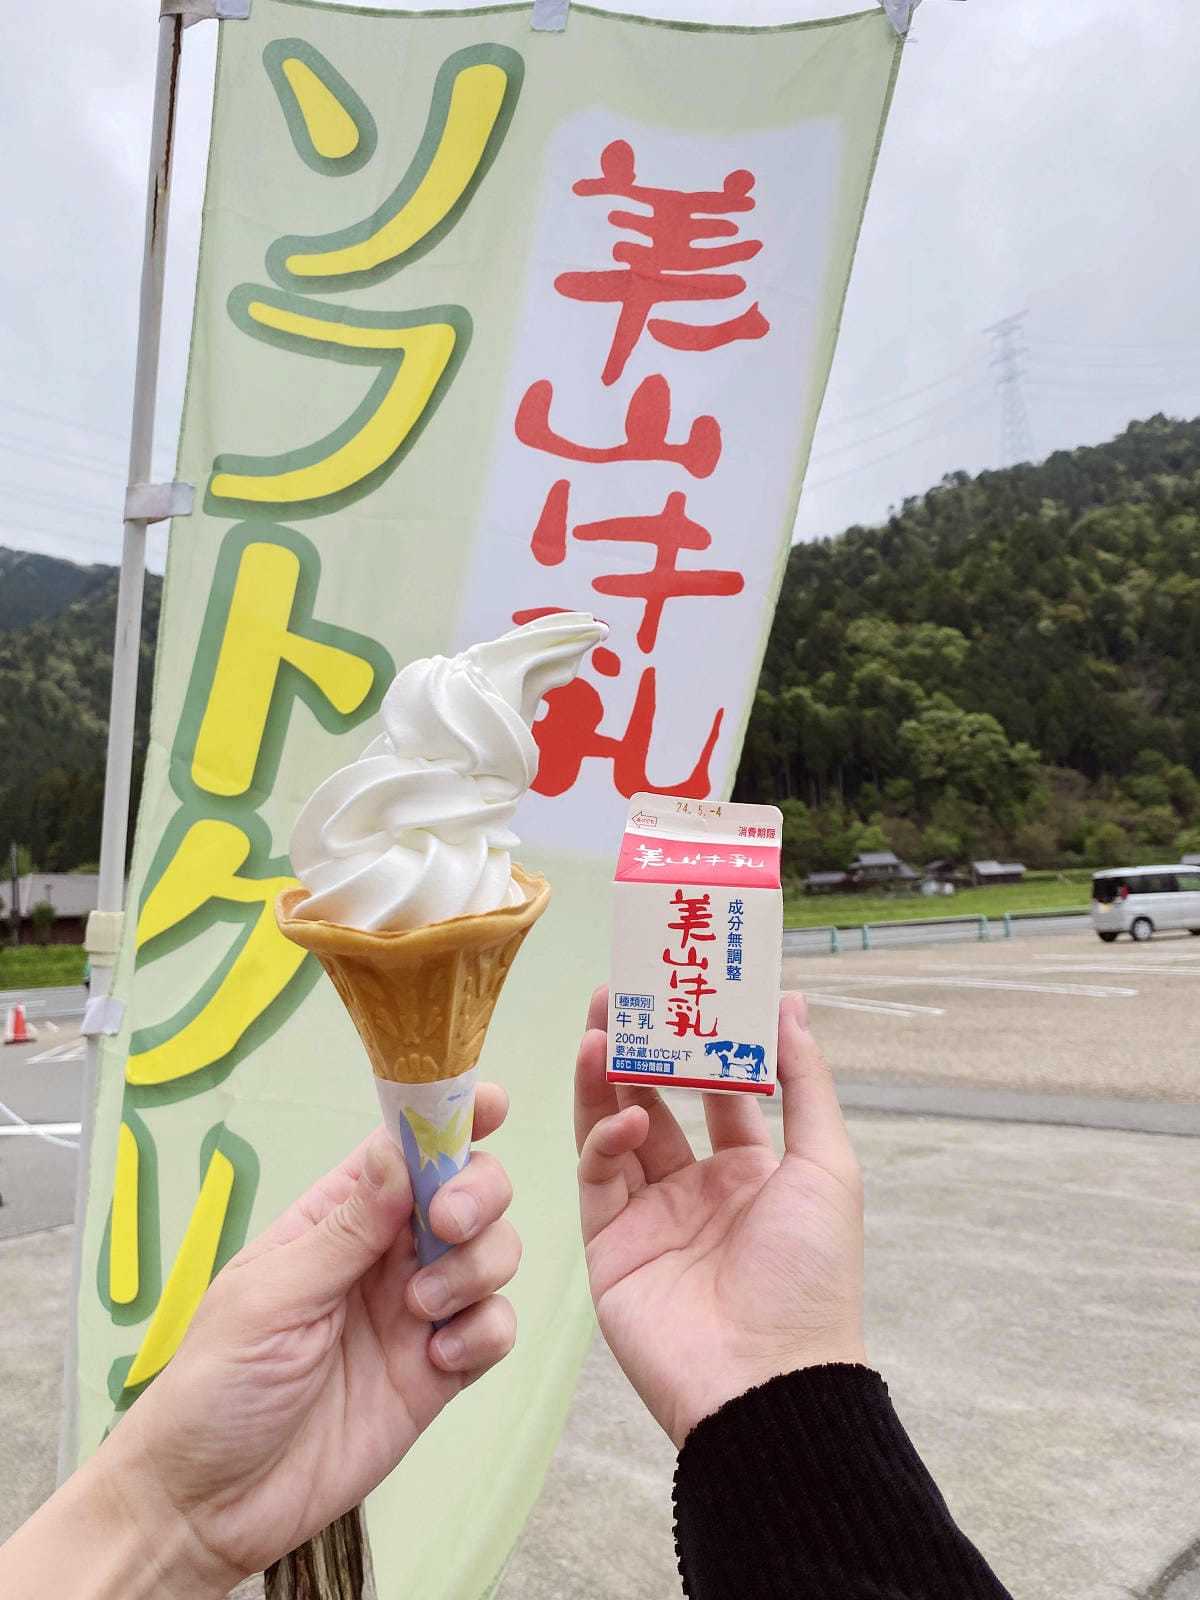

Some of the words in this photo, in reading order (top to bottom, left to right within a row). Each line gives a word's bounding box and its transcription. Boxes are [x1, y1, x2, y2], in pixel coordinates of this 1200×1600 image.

[513, 139, 770, 800] 美山牛乳
[738, 826, 776, 839] 消費期限
[633, 843, 765, 870] 美山牛乳
[726, 899, 744, 982] 成分無調整
[662, 888, 718, 1037] 美山牛乳
[618, 995, 651, 1009] 種類別
[615, 1032, 649, 1045] 200ml
[615, 1045, 693, 1062] 要冷蔵10℃以下
